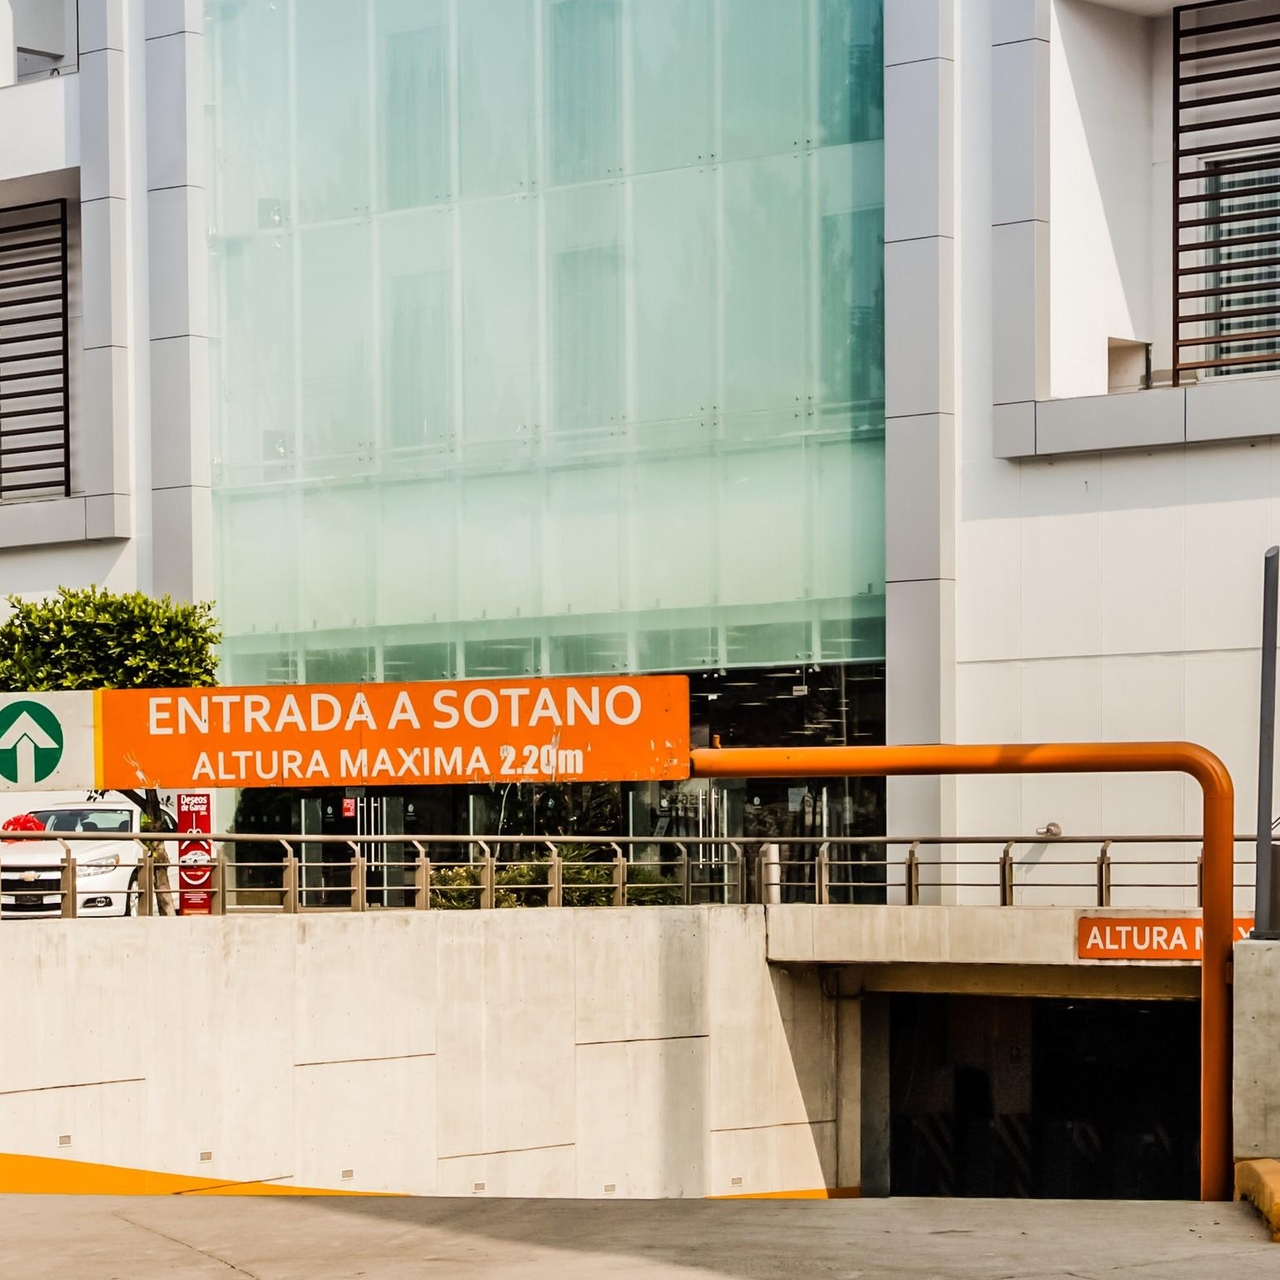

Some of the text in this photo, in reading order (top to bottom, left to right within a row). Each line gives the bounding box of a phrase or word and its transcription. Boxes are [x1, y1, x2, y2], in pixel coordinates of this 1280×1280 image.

[148, 685, 642, 735] ENTRADA A SOTANO
[191, 743, 584, 780] ALTURA MAXIMA 2.20m
[181, 795, 208, 805] Deseos
[181, 804, 189, 812] de
[1085, 926, 1189, 950] ALTURA
